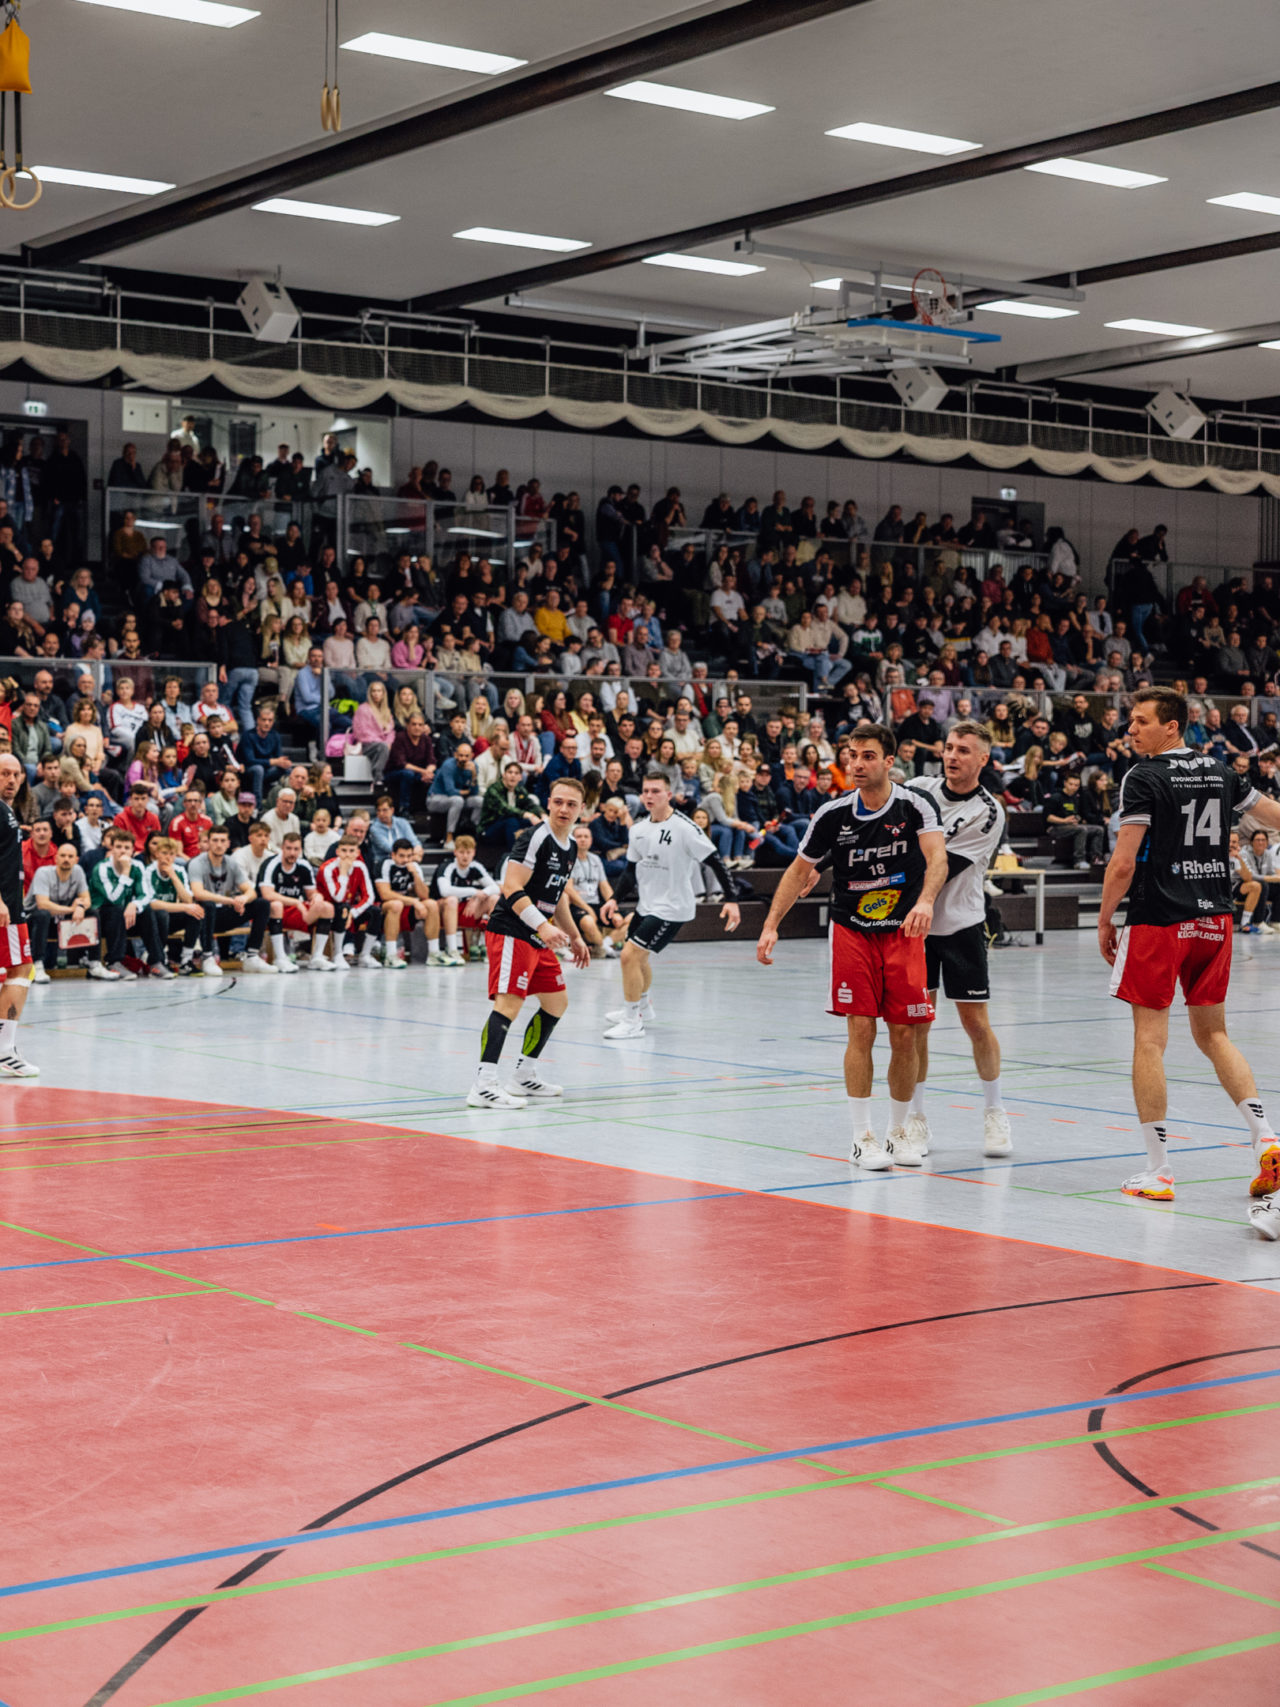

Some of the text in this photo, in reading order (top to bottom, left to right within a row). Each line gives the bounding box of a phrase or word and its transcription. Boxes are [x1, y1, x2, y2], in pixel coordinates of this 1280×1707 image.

[1181, 798, 1221, 846] 14
[659, 829, 672, 845] 14
[868, 863, 886, 876] 18
[1182, 859, 1226, 874] Rhein
[863, 897, 888, 914] Geis
[1180, 922, 1195, 931] DER
